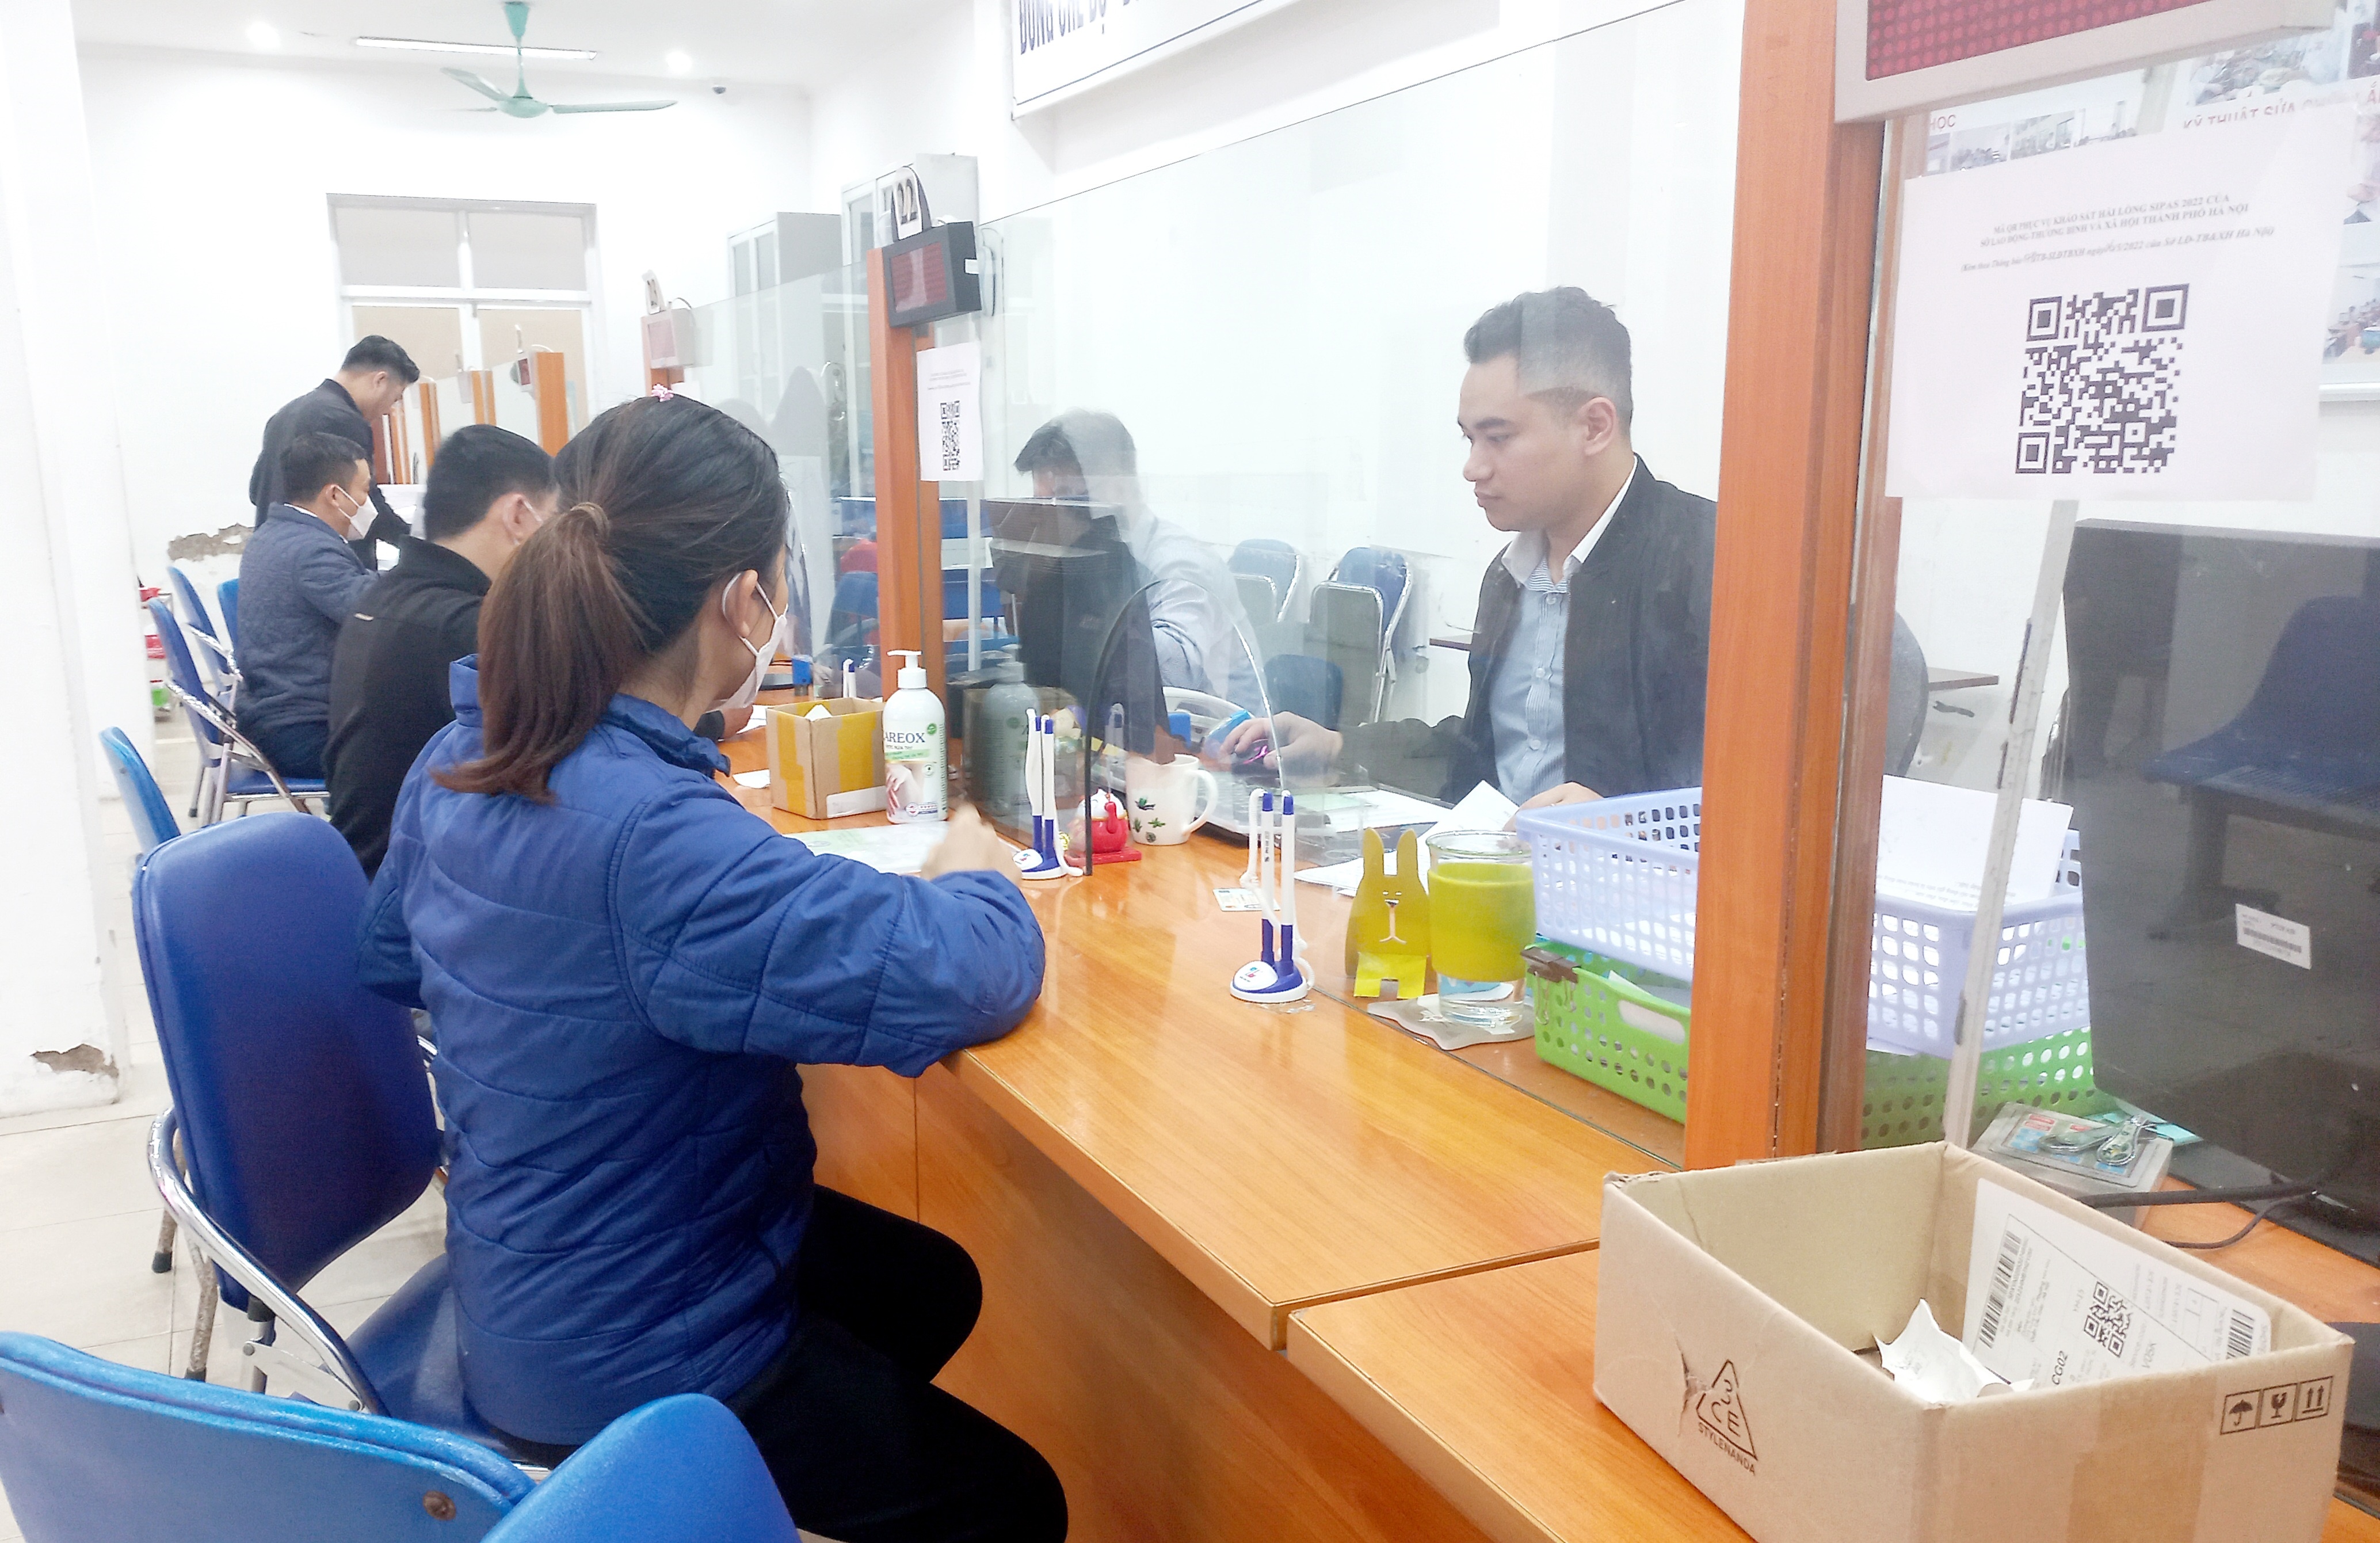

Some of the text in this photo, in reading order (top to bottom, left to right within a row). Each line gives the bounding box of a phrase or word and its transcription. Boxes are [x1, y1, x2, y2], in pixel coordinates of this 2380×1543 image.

[897, 178, 918, 225] 22
[2051, 1350, 2068, 1386] CG02
[1698, 1422, 1756, 1475] STYLENANDA
